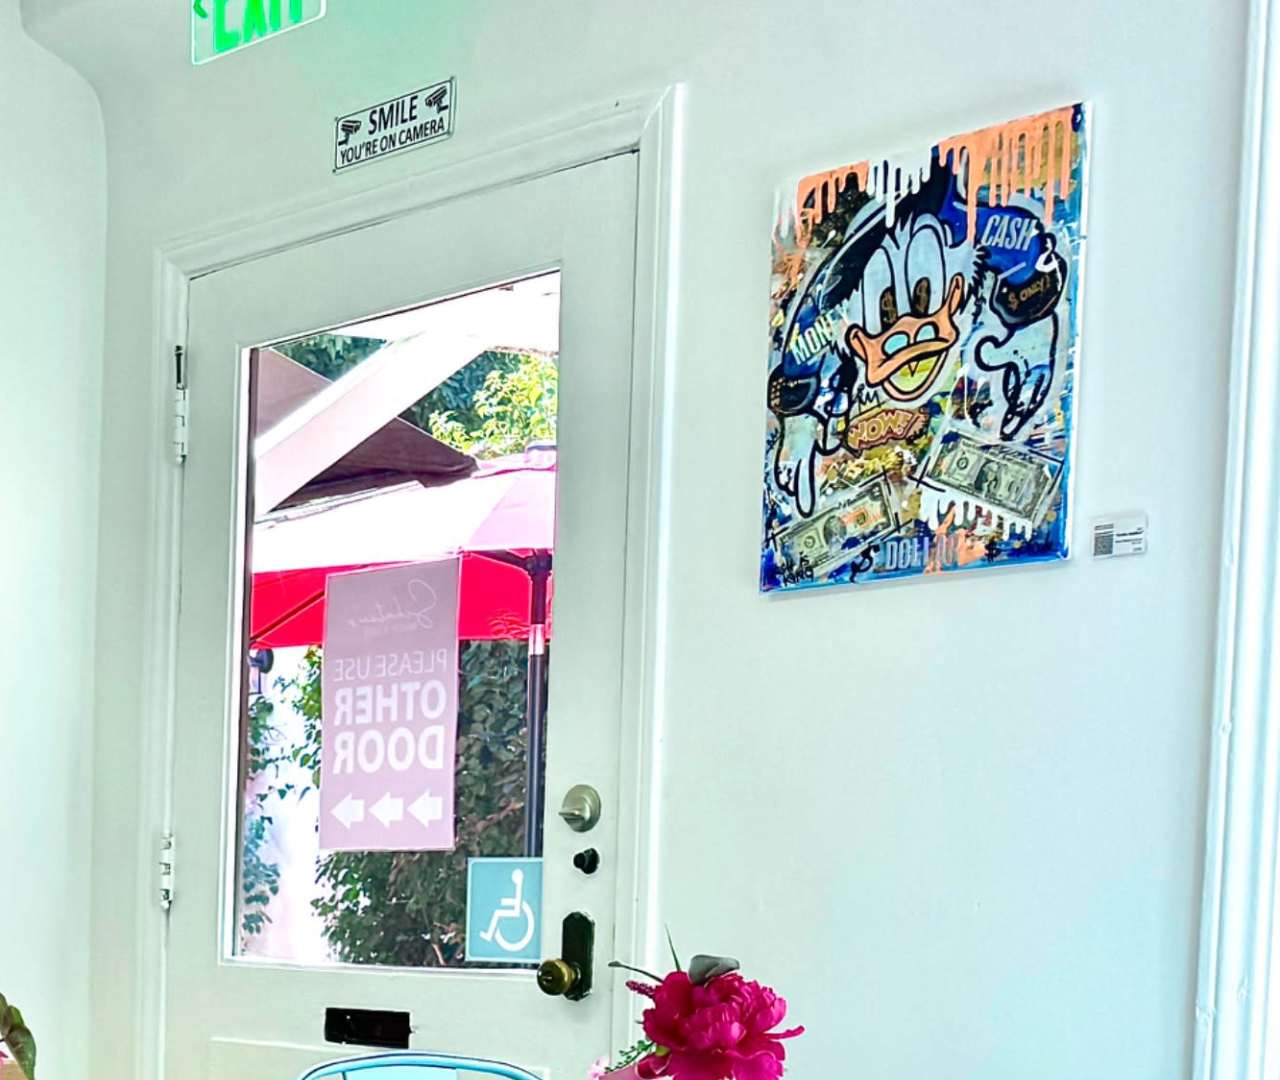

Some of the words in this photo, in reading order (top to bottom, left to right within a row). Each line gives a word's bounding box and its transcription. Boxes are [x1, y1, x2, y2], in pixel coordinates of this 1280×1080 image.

[368, 95, 418, 135] SMILE
[340, 138, 378, 164] YOU'RE
[380, 133, 396, 152] ON
[399, 116, 444, 145] CAMERA
[981, 214, 1038, 251] CASH
